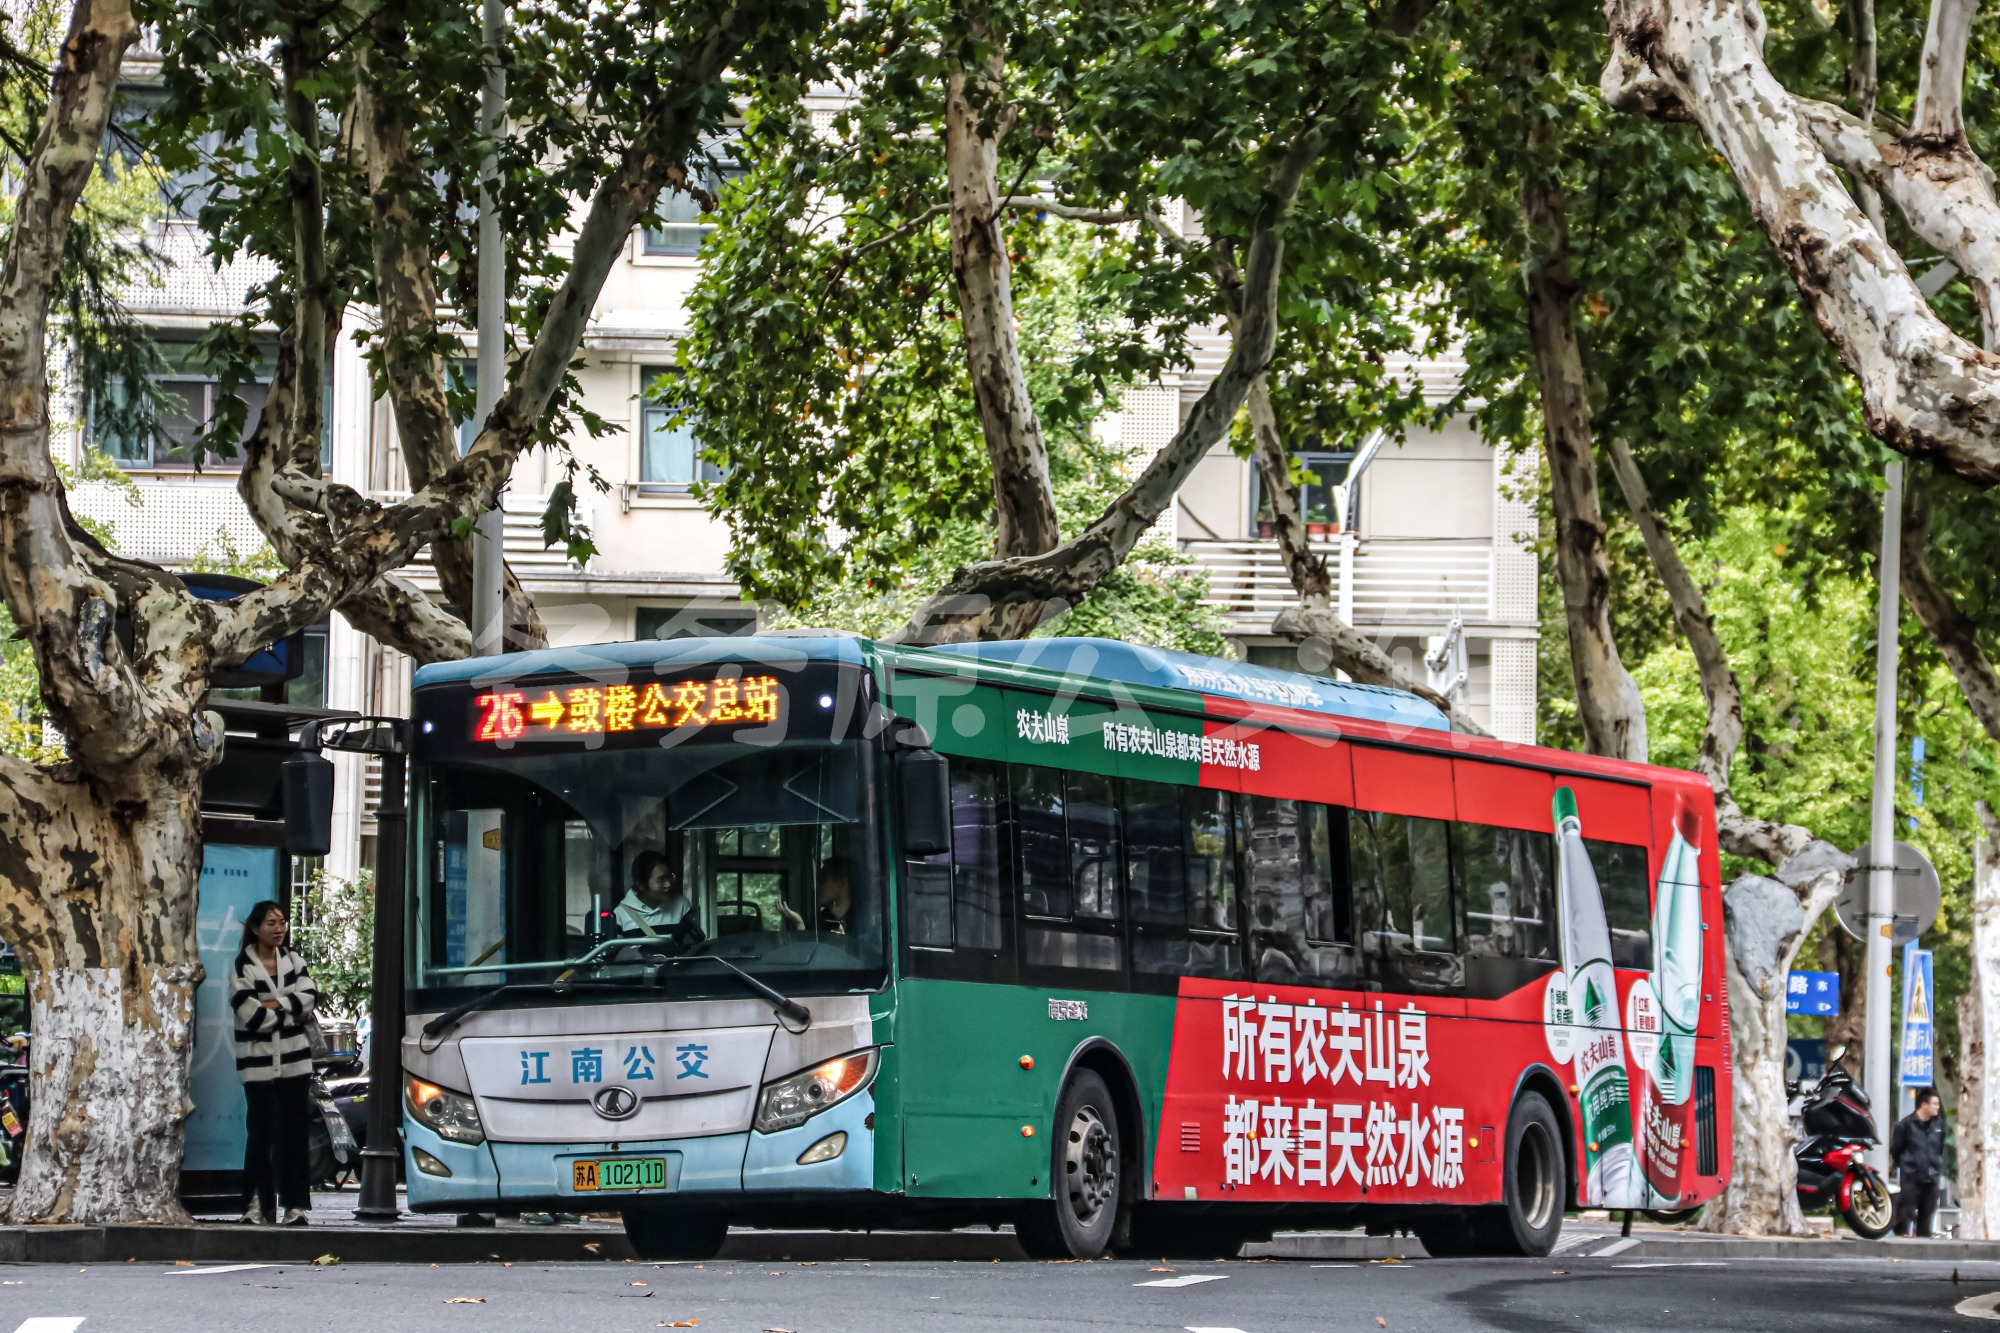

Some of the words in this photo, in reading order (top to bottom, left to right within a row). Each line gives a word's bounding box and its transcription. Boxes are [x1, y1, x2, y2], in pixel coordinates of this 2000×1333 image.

[477, 693, 524, 740] 26
[568, 675, 780, 733] 鼓楼公交总站
[1017, 708, 1070, 745] 农夫山泉
[1103, 721, 1260, 771] 所有农夫山泉都来自天然水源
[1789, 975, 1809, 995] 路
[520, 1043, 709, 1085] 江南公交
[1222, 993, 1431, 1089] 所有农夫山泉
[1581, 1033, 1618, 1079] 农夫山泉
[1223, 1095, 1465, 1189] 都来自天然水源
